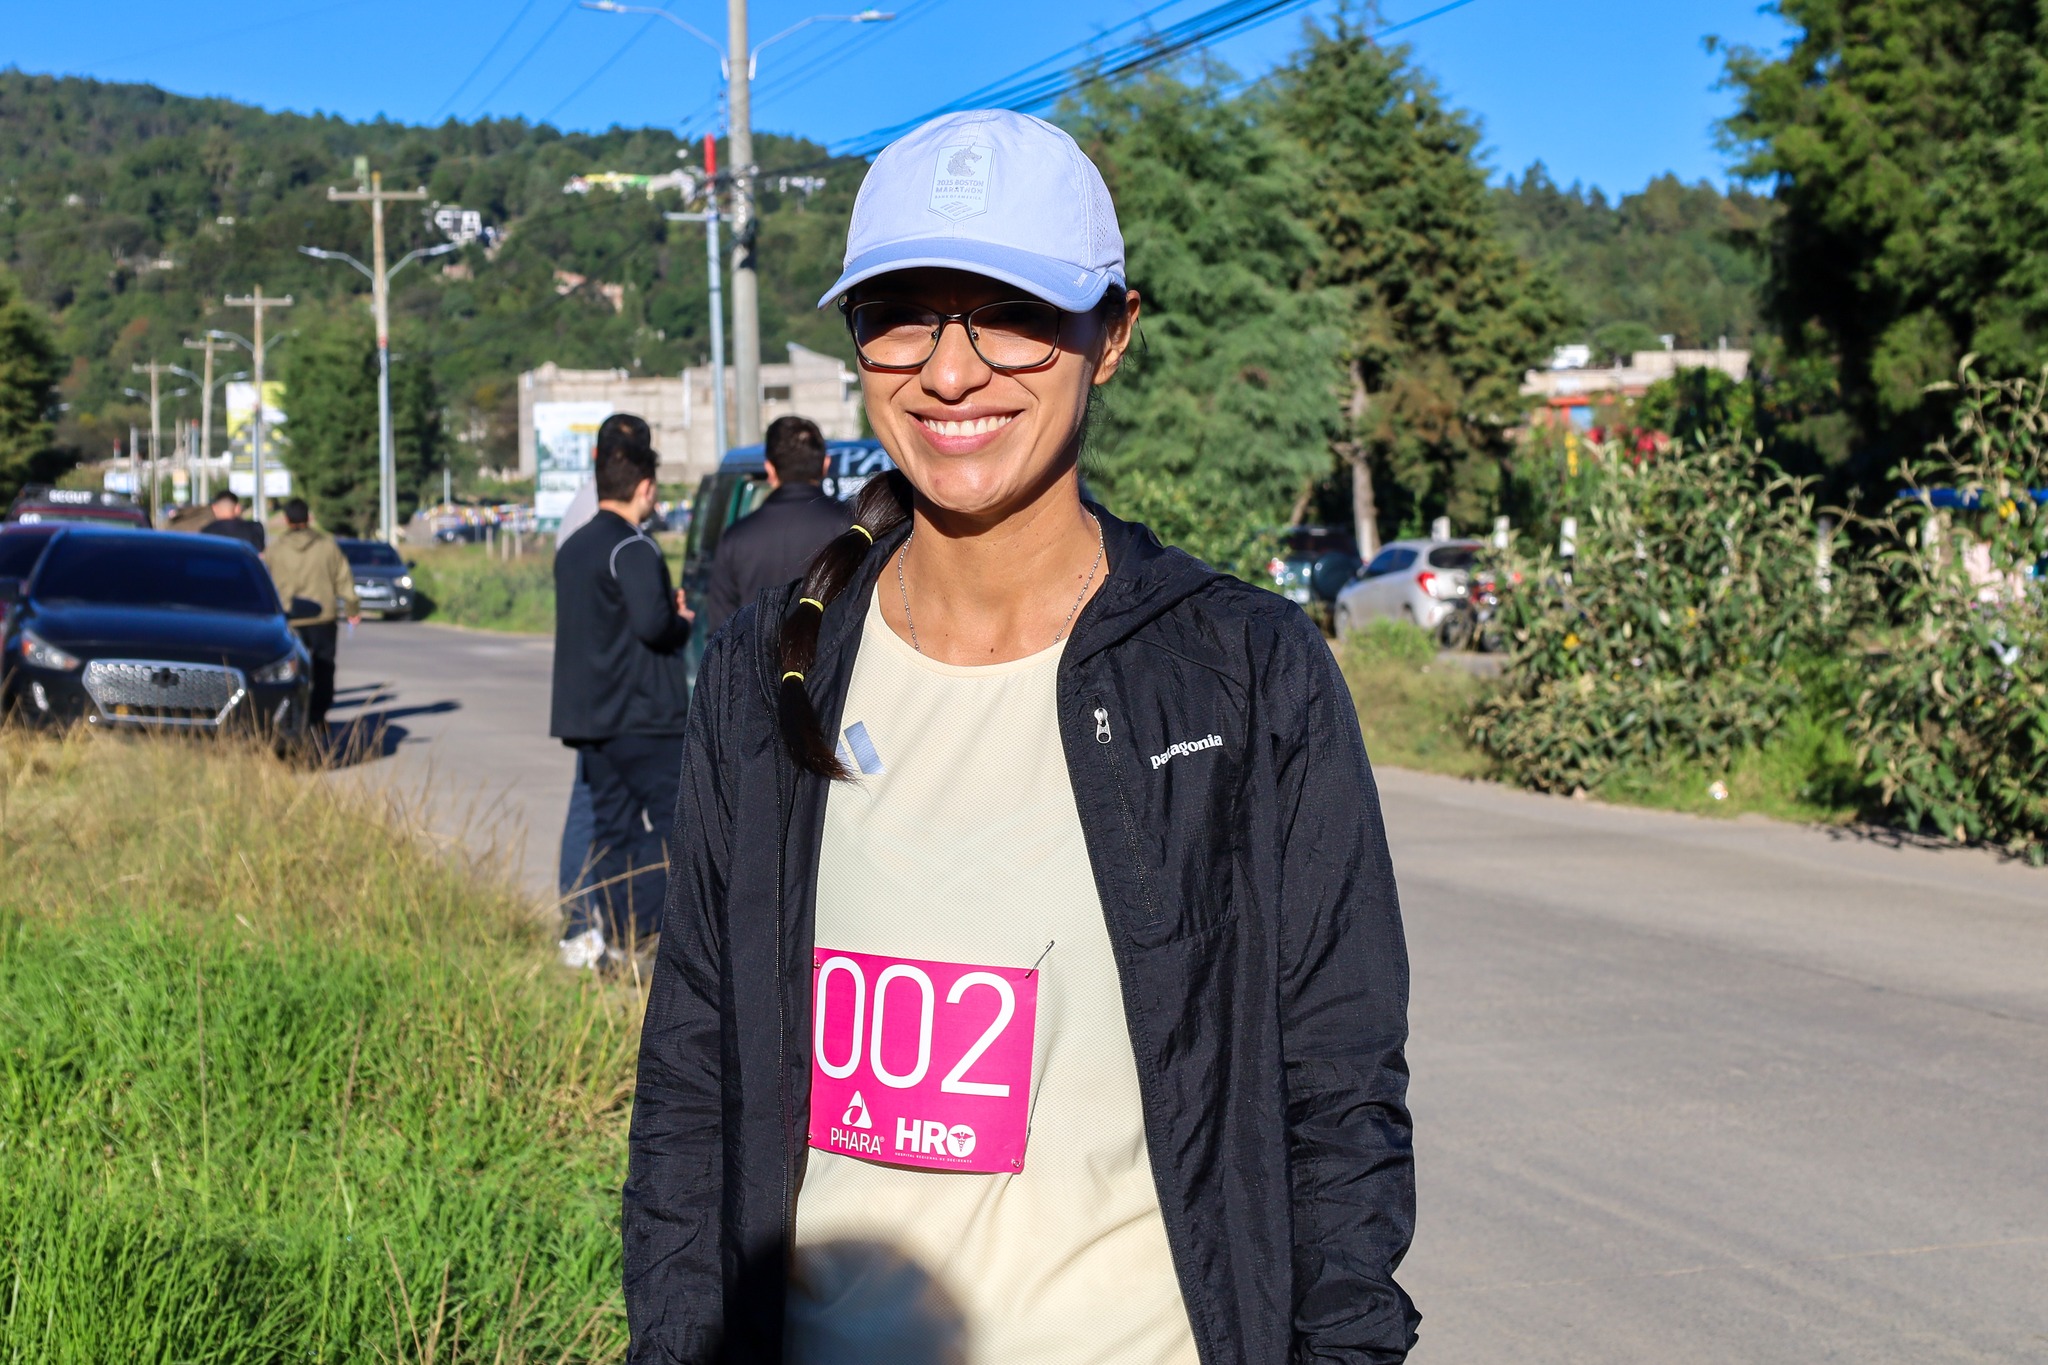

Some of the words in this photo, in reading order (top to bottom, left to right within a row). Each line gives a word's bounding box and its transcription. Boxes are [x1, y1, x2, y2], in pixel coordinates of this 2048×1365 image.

[954, 179, 984, 187] BOSTON
[49, 489, 92, 504] SCOUT
[1150, 734, 1223, 770] patagonia
[815, 956, 1016, 1098] 002
